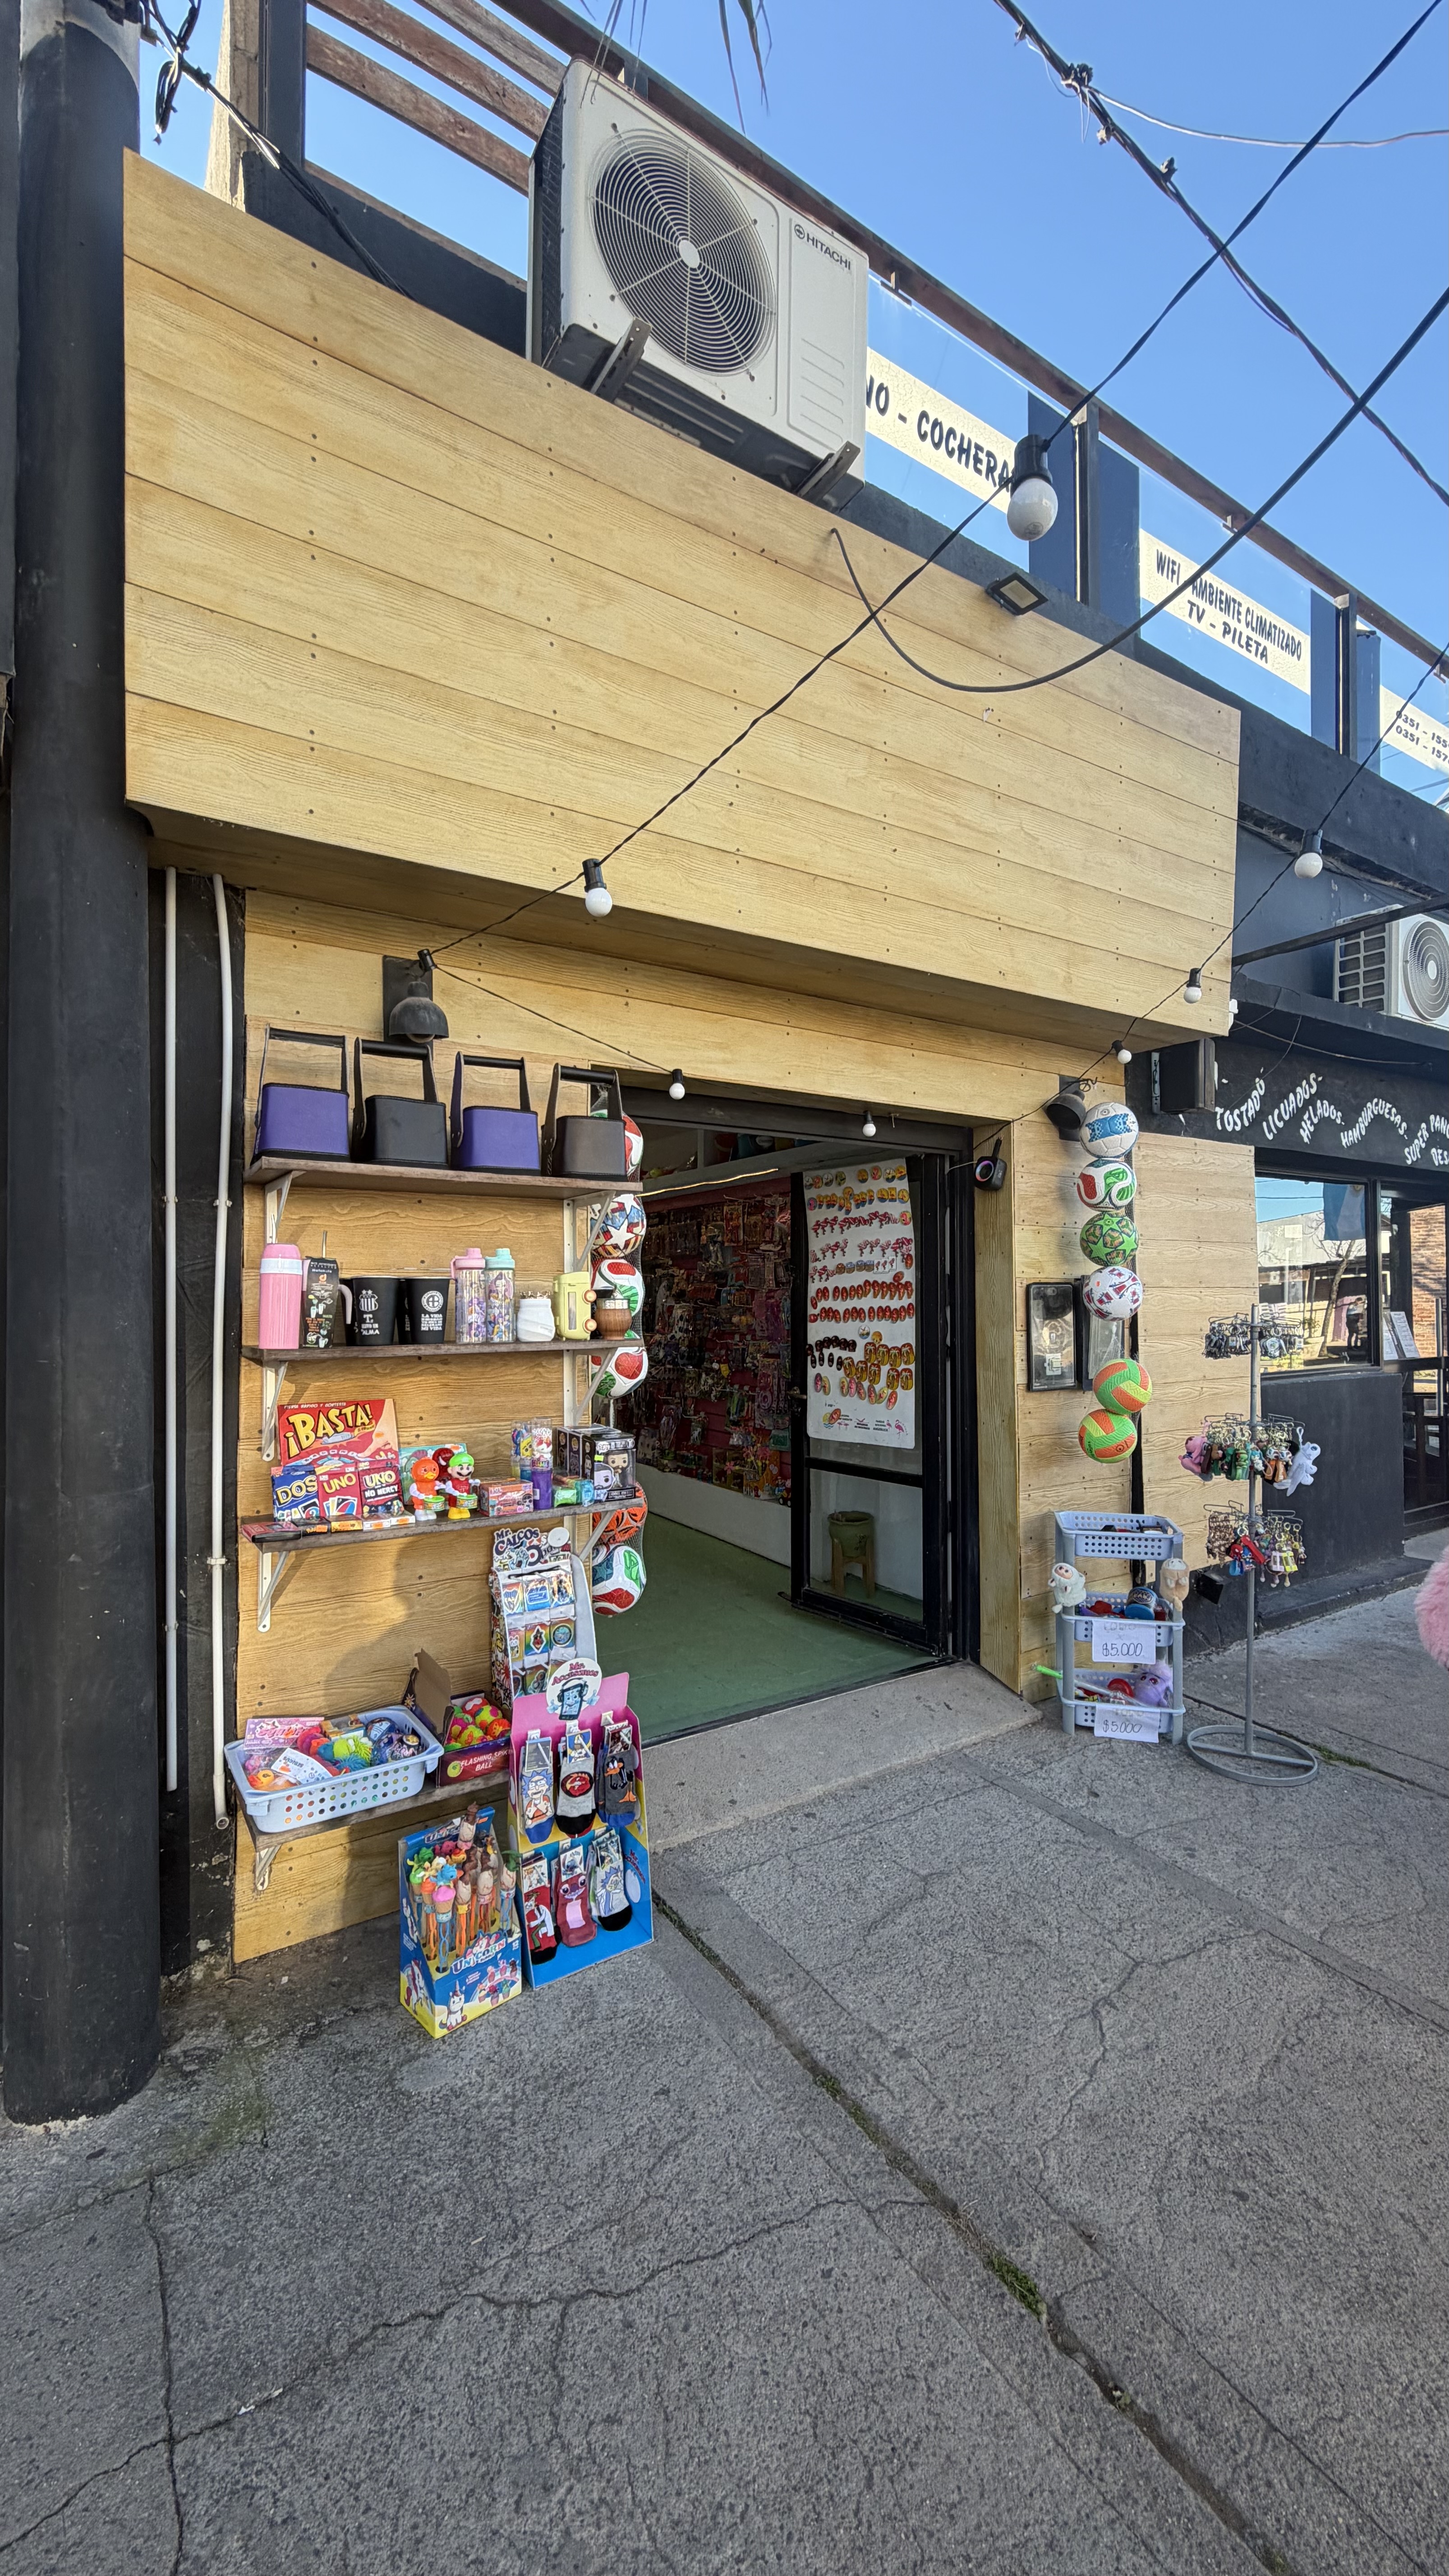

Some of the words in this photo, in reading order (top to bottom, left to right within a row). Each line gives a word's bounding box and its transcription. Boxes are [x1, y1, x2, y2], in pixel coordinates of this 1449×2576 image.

[806, 232, 851, 271] HITACHI
[1156, 548, 1181, 586] WIFI
[1191, 577, 1242, 625] AMBIENTE
[1245, 606, 1302, 662] CLIMATIZADO
[1187, 599, 1206, 624] TV
[1222, 621, 1268, 664] PILETA
[1396, 710, 1420, 731] 0351
[1431, 732, 1449, 749] 155
[1396, 725, 1420, 746] 0351
[1431, 746, 1449, 765] 157
[1404, 1122, 1429, 1165] SUPER
[1431, 1147, 1449, 1166] DES
[284, 1403, 373, 1459] ¡BASTA!
[276, 1475, 318, 1505] DOS
[323, 1473, 356, 1494] UNO
[363, 1470, 396, 1488] UNO
[364, 1489, 376, 1498] NO
[377, 1485, 399, 1495] MERCY
[494, 1528, 539, 1556] CALCOS
[1102, 1642, 1143, 1657] $5.000
[460, 1753, 492, 1767] FLASHING
[475, 1761, 493, 1772] BALL
[452, 1938, 506, 1974] UNICORN
